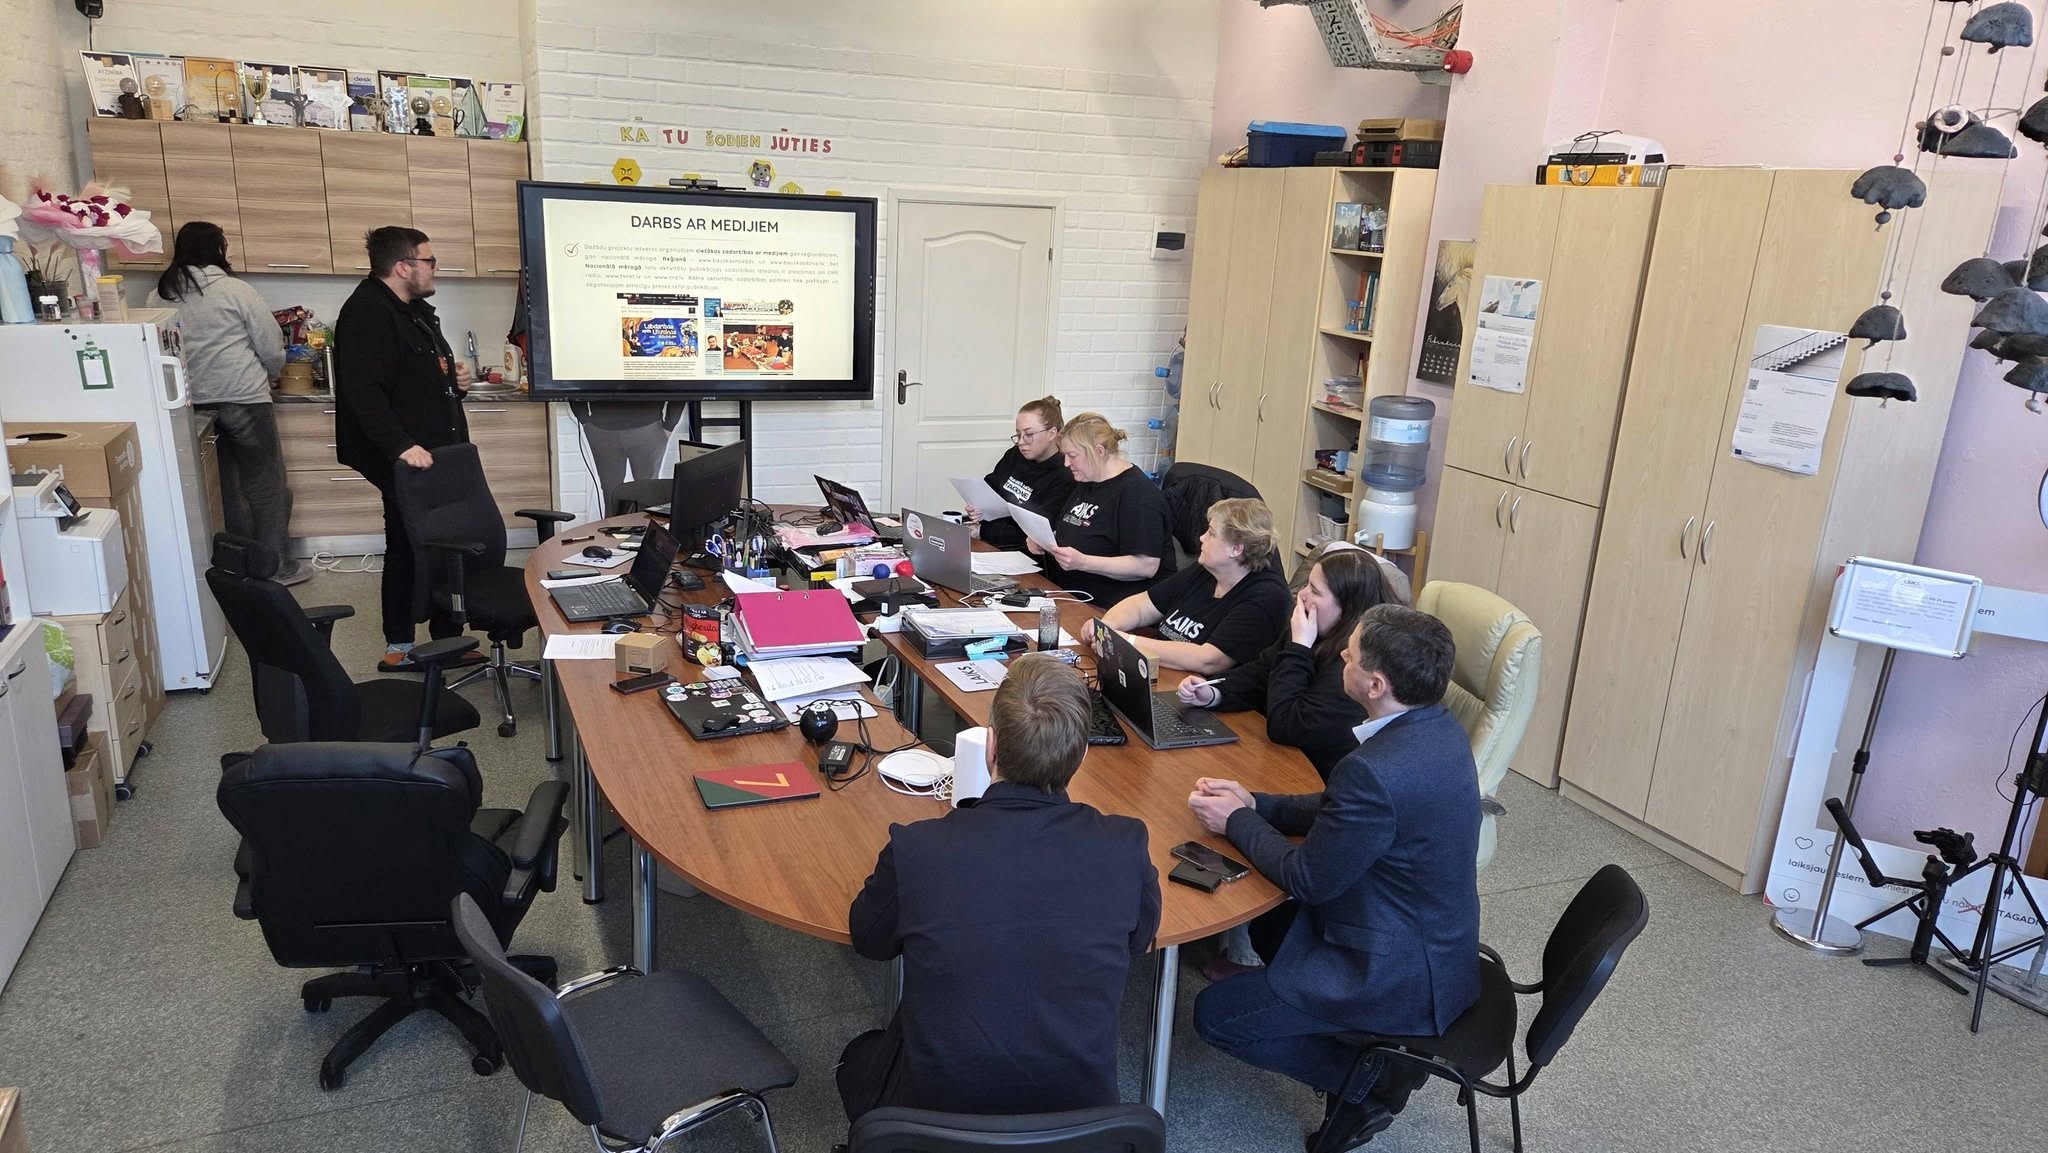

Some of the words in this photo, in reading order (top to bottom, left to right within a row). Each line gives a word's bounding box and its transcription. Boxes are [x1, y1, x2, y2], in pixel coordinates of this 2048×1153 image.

[662, 129, 689, 145] TU
[705, 130, 761, 148] ŠODIEN
[770, 128, 832, 154] JŪTIES
[631, 215, 682, 230] DARBS
[686, 218, 706, 231] AR
[711, 219, 779, 233] MEDIJIEM
[1165, 609, 1205, 639] LAIKS
[1788, 857, 1865, 884] laiksjauesiem
